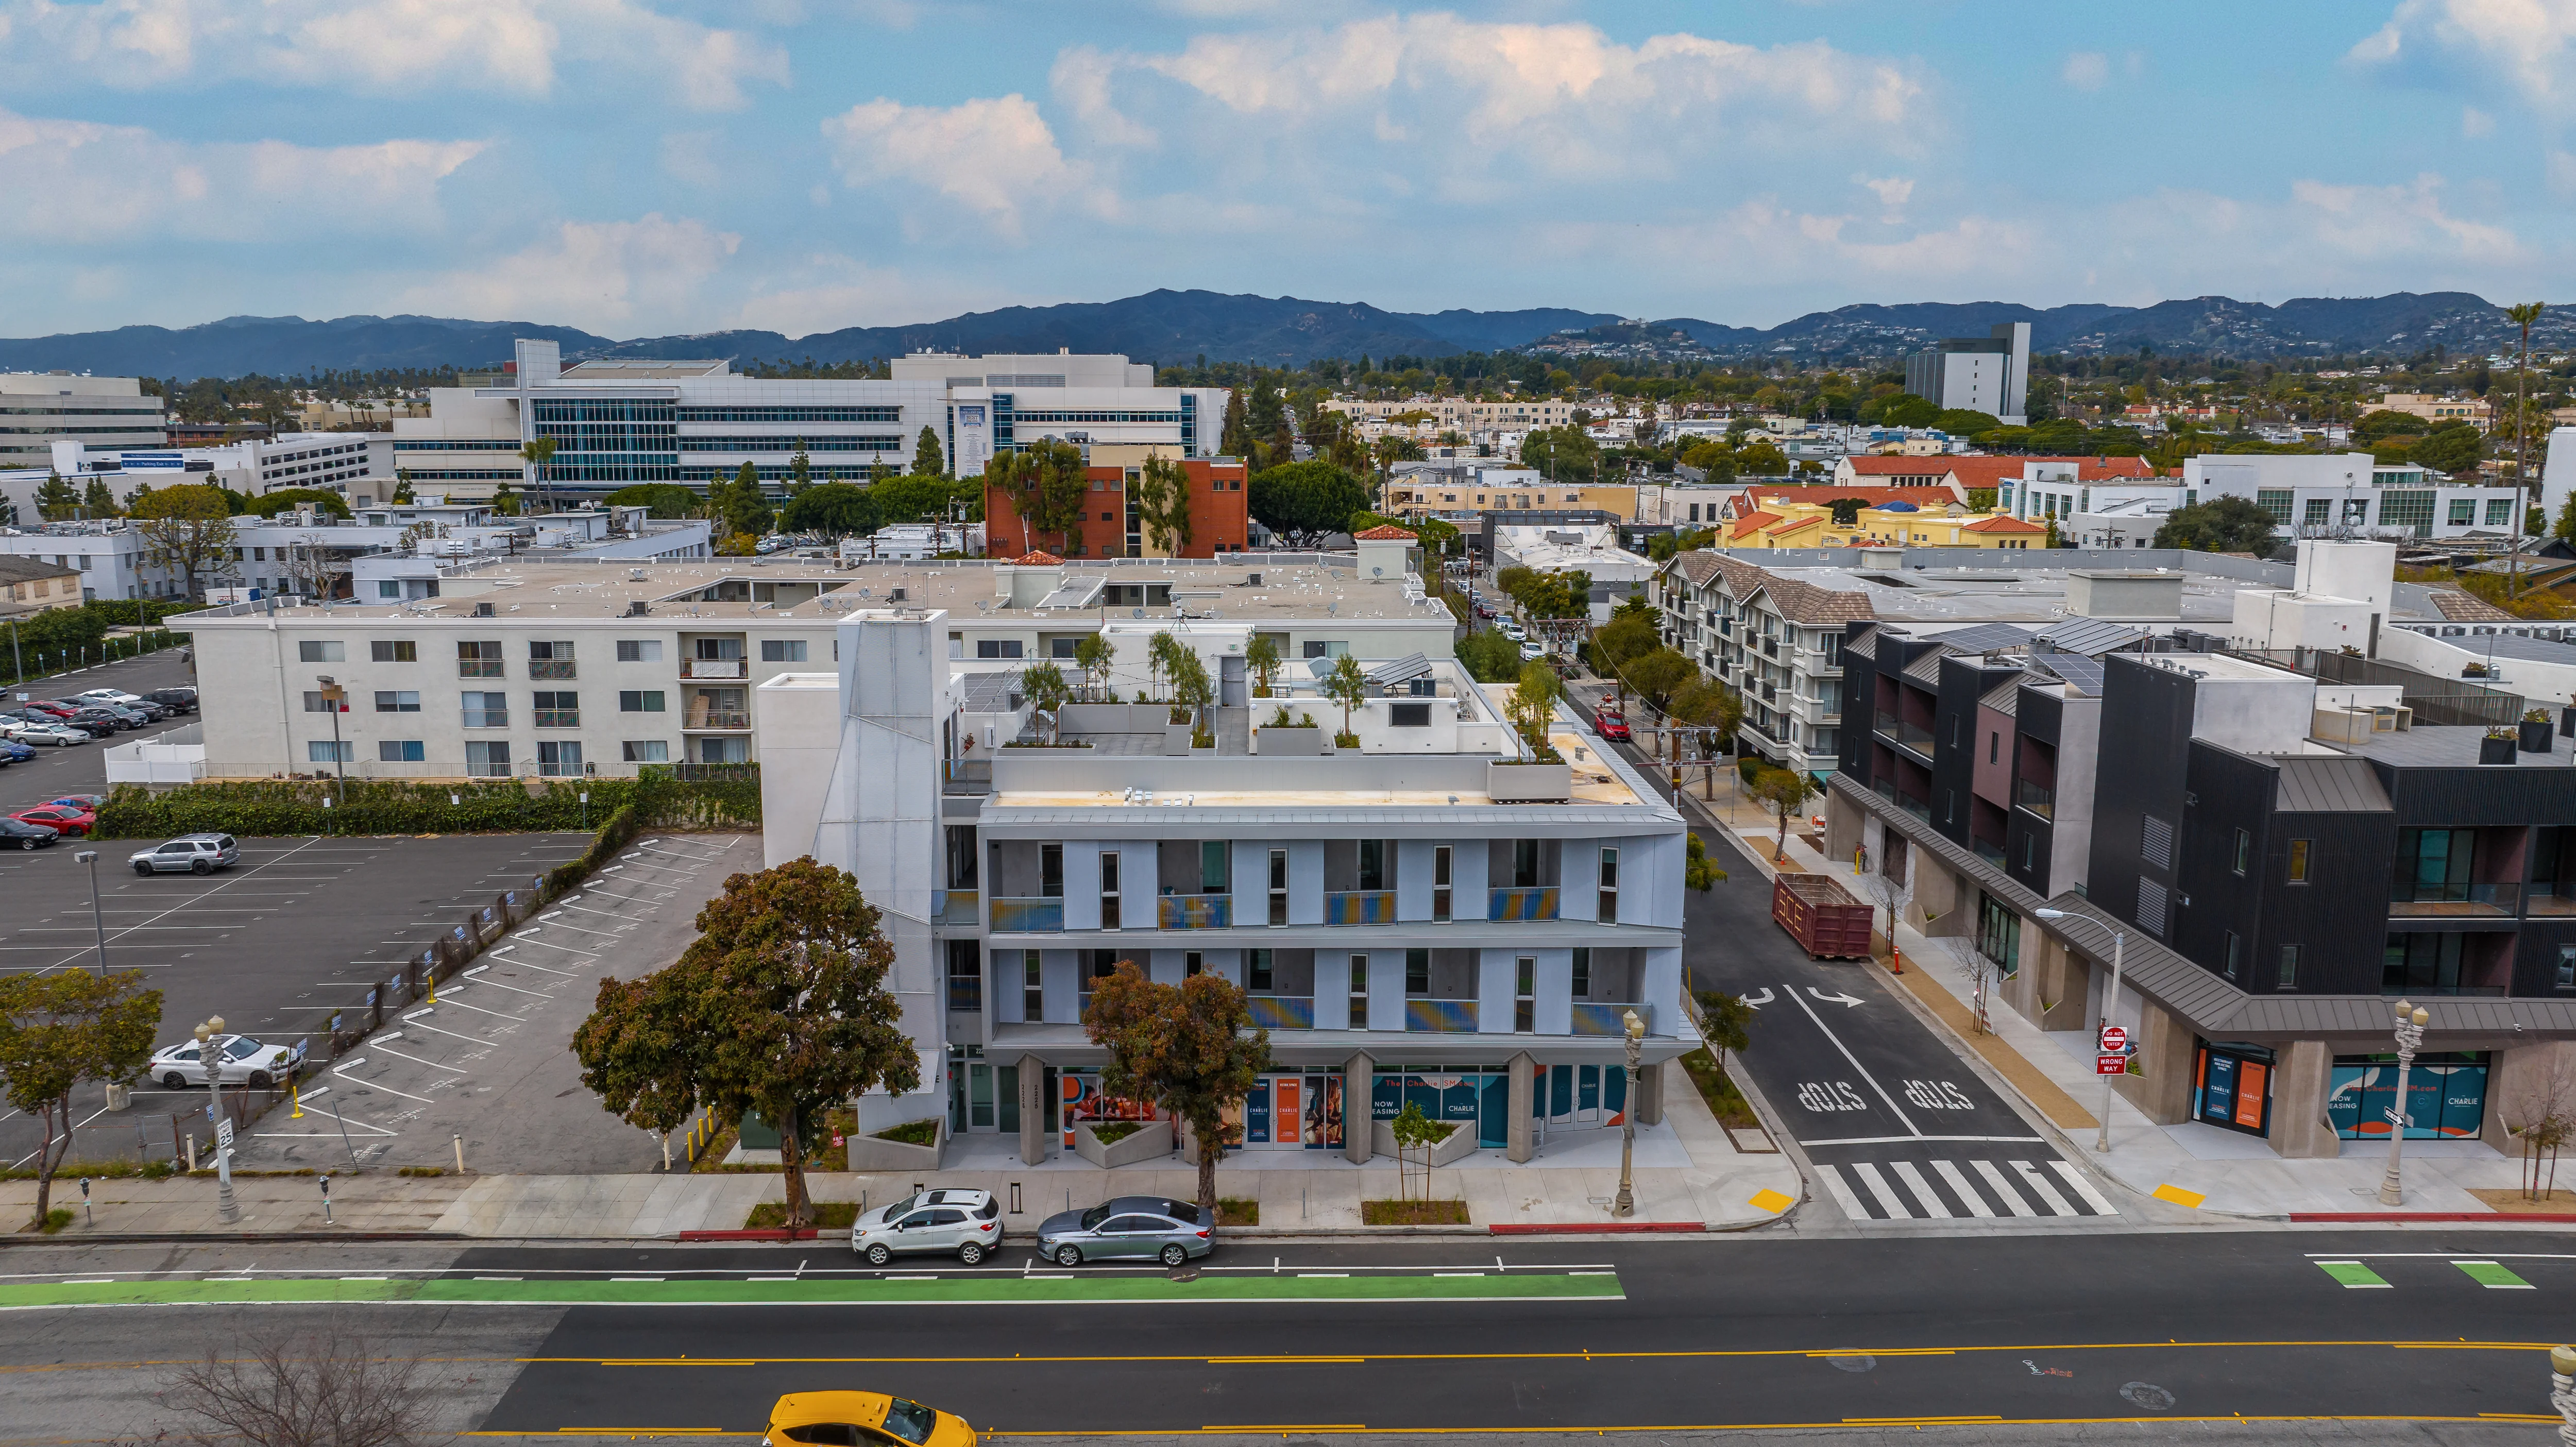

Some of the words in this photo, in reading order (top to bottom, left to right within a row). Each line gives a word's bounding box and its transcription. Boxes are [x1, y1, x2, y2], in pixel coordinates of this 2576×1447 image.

[423, 1077, 461, 1093] RESERVED
[2211, 1085, 2230, 1094] CHARLIE
[1798, 1082, 1867, 1112] STOP
[1903, 1080, 1975, 1110] STOP
[2241, 1093, 2260, 1101] CHARLIE
[387, 1107, 426, 1124] RESERVED
[218, 1121, 230, 1131] SPEED
[220, 1127, 230, 1135] LIMIT
[221, 1132, 232, 1146] 25
